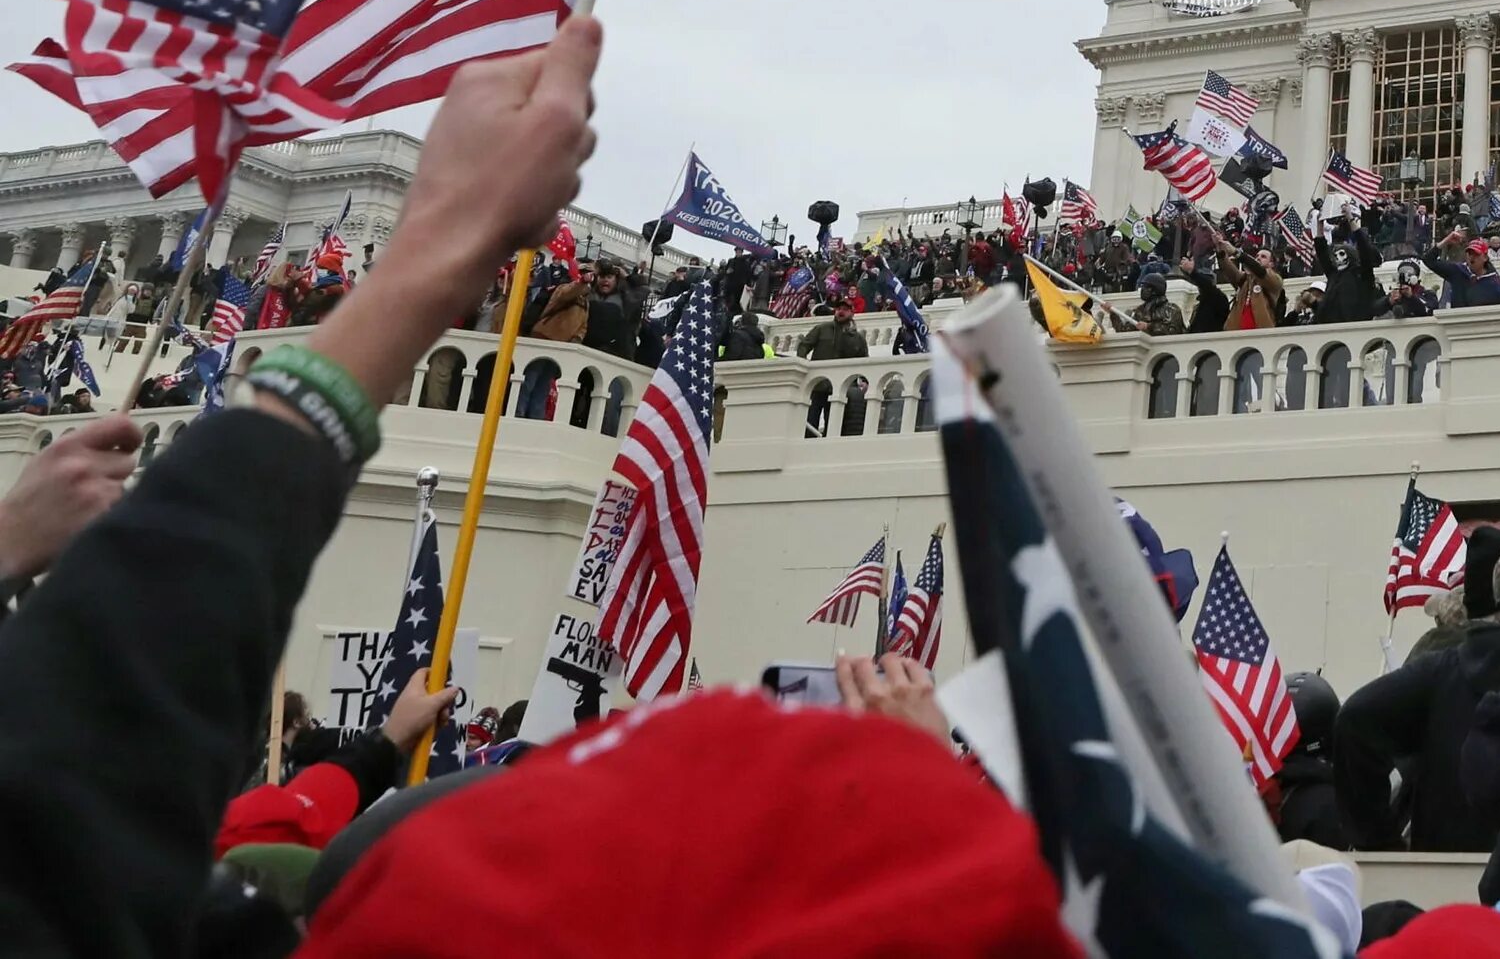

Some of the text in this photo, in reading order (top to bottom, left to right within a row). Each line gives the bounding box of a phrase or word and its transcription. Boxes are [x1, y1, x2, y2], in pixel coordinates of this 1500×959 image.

[676, 210, 700, 225] KEEP
[579, 558, 610, 583] SA
[559, 641, 614, 673] MAN
